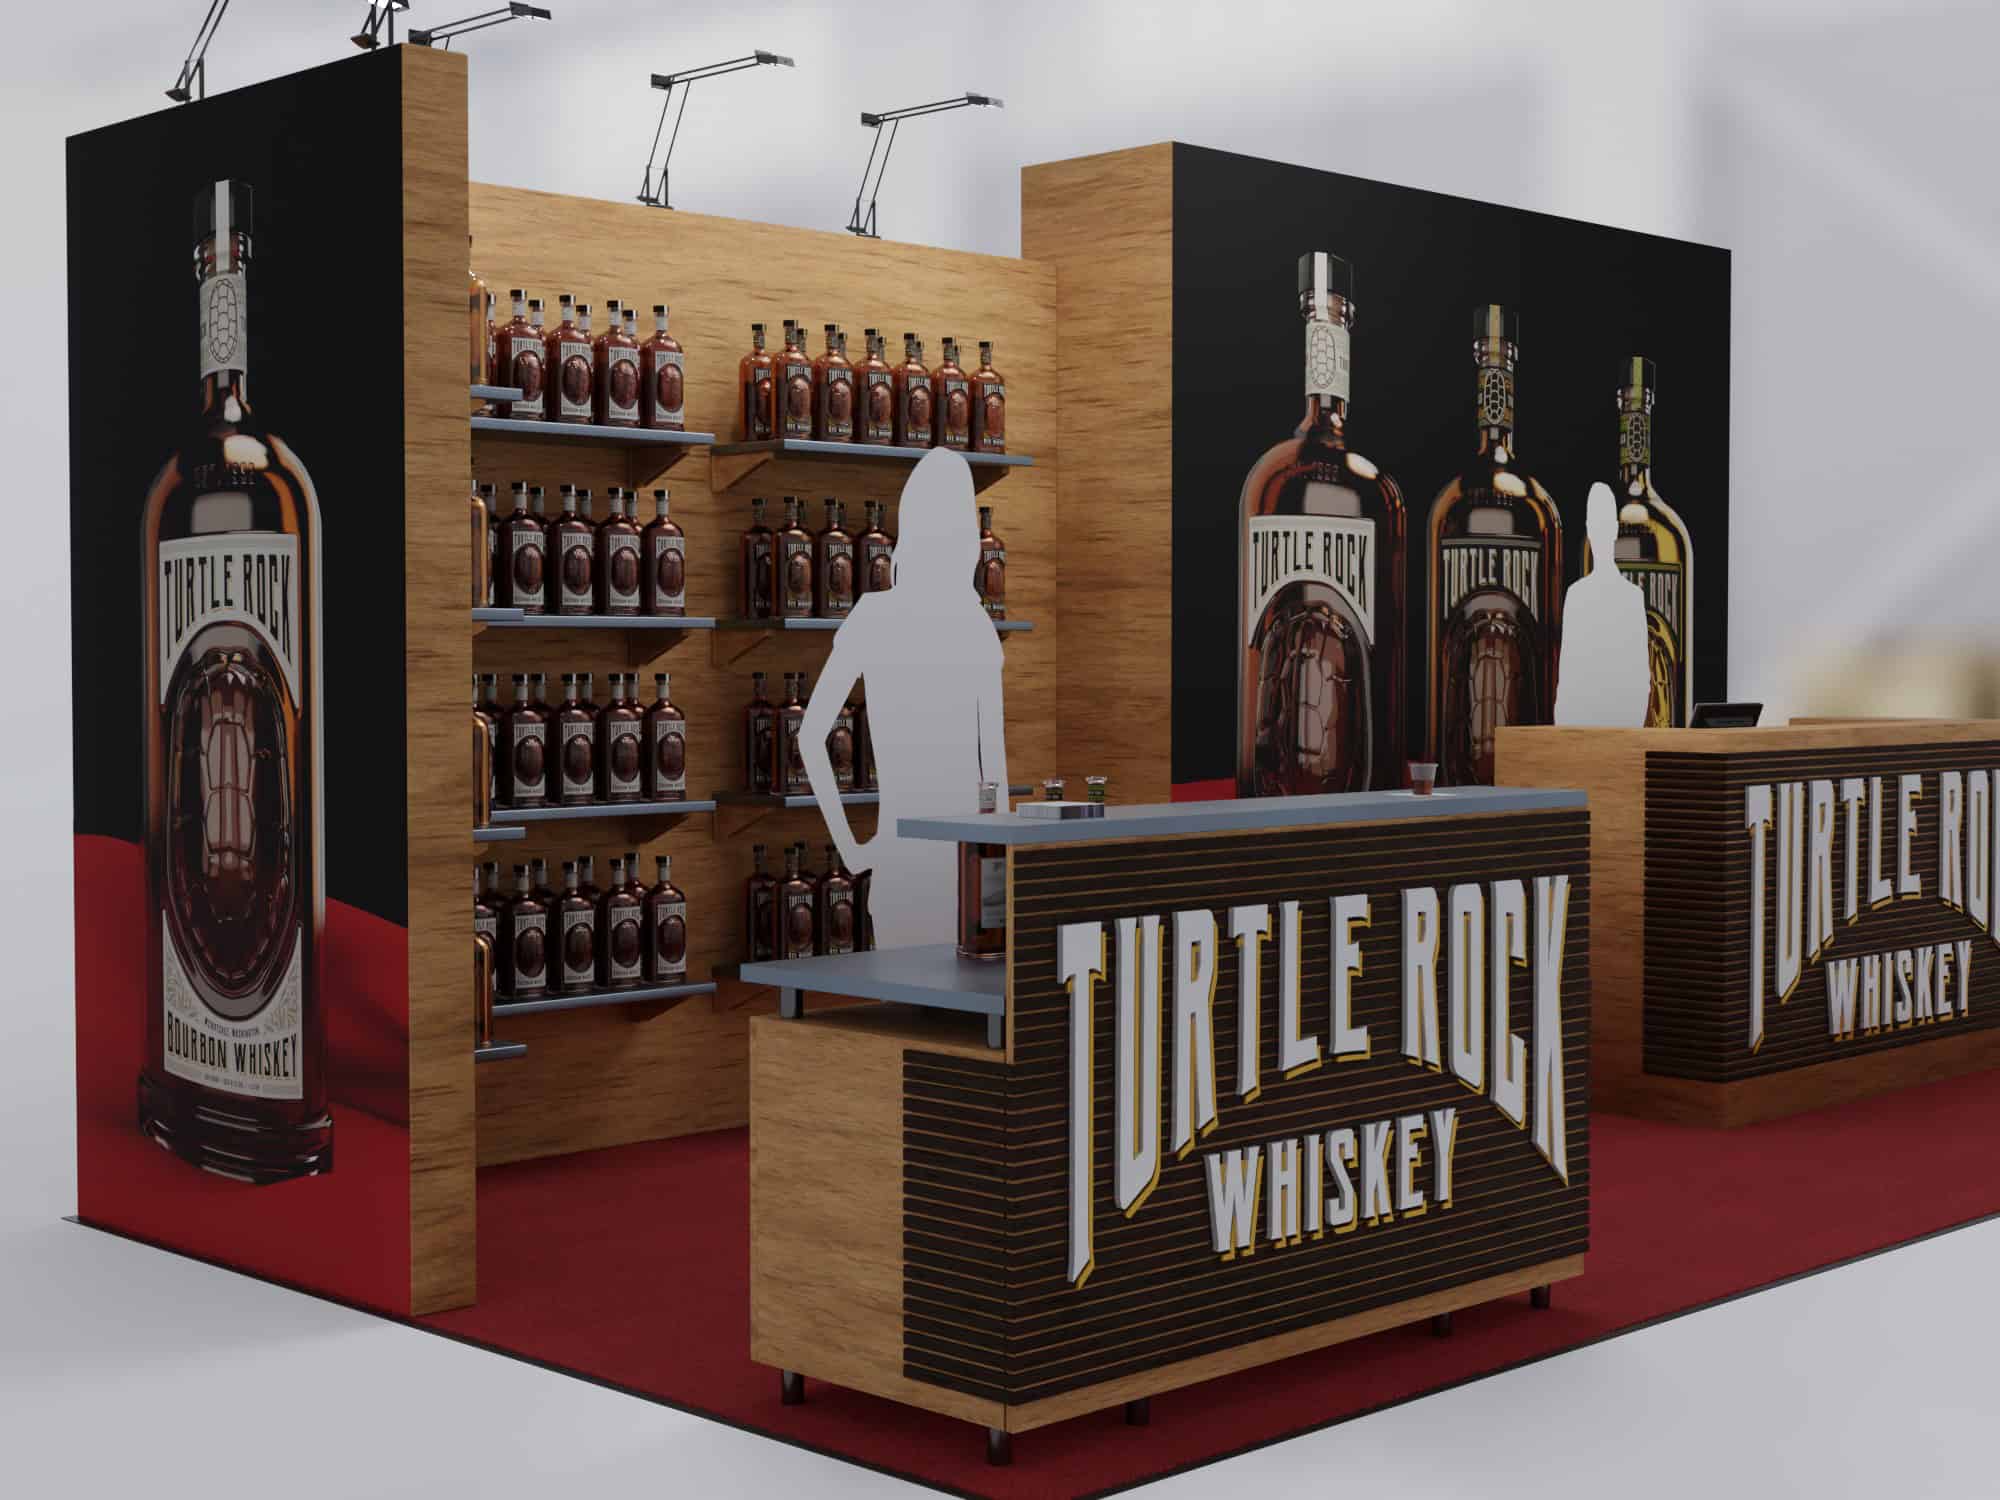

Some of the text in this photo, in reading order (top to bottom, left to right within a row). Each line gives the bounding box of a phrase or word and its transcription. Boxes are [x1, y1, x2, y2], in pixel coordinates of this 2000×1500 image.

[164, 553, 291, 666] TURTLE ROCK
[1252, 530, 1368, 613] TURTLE ROCK
[1442, 547, 1539, 622] TURTLE ROCK
[1649, 572, 1679, 638] ROCK
[1745, 773, 1922, 1055] TURTLE
[1825, 939, 1972, 1042] WHISKEY
[167, 1010, 227, 1069] BOURBON
[234, 1034, 297, 1078] WHISKEY
[1057, 875, 1571, 1290] TURTLE ROCK
[1203, 1108, 1459, 1261] WHISKEY
